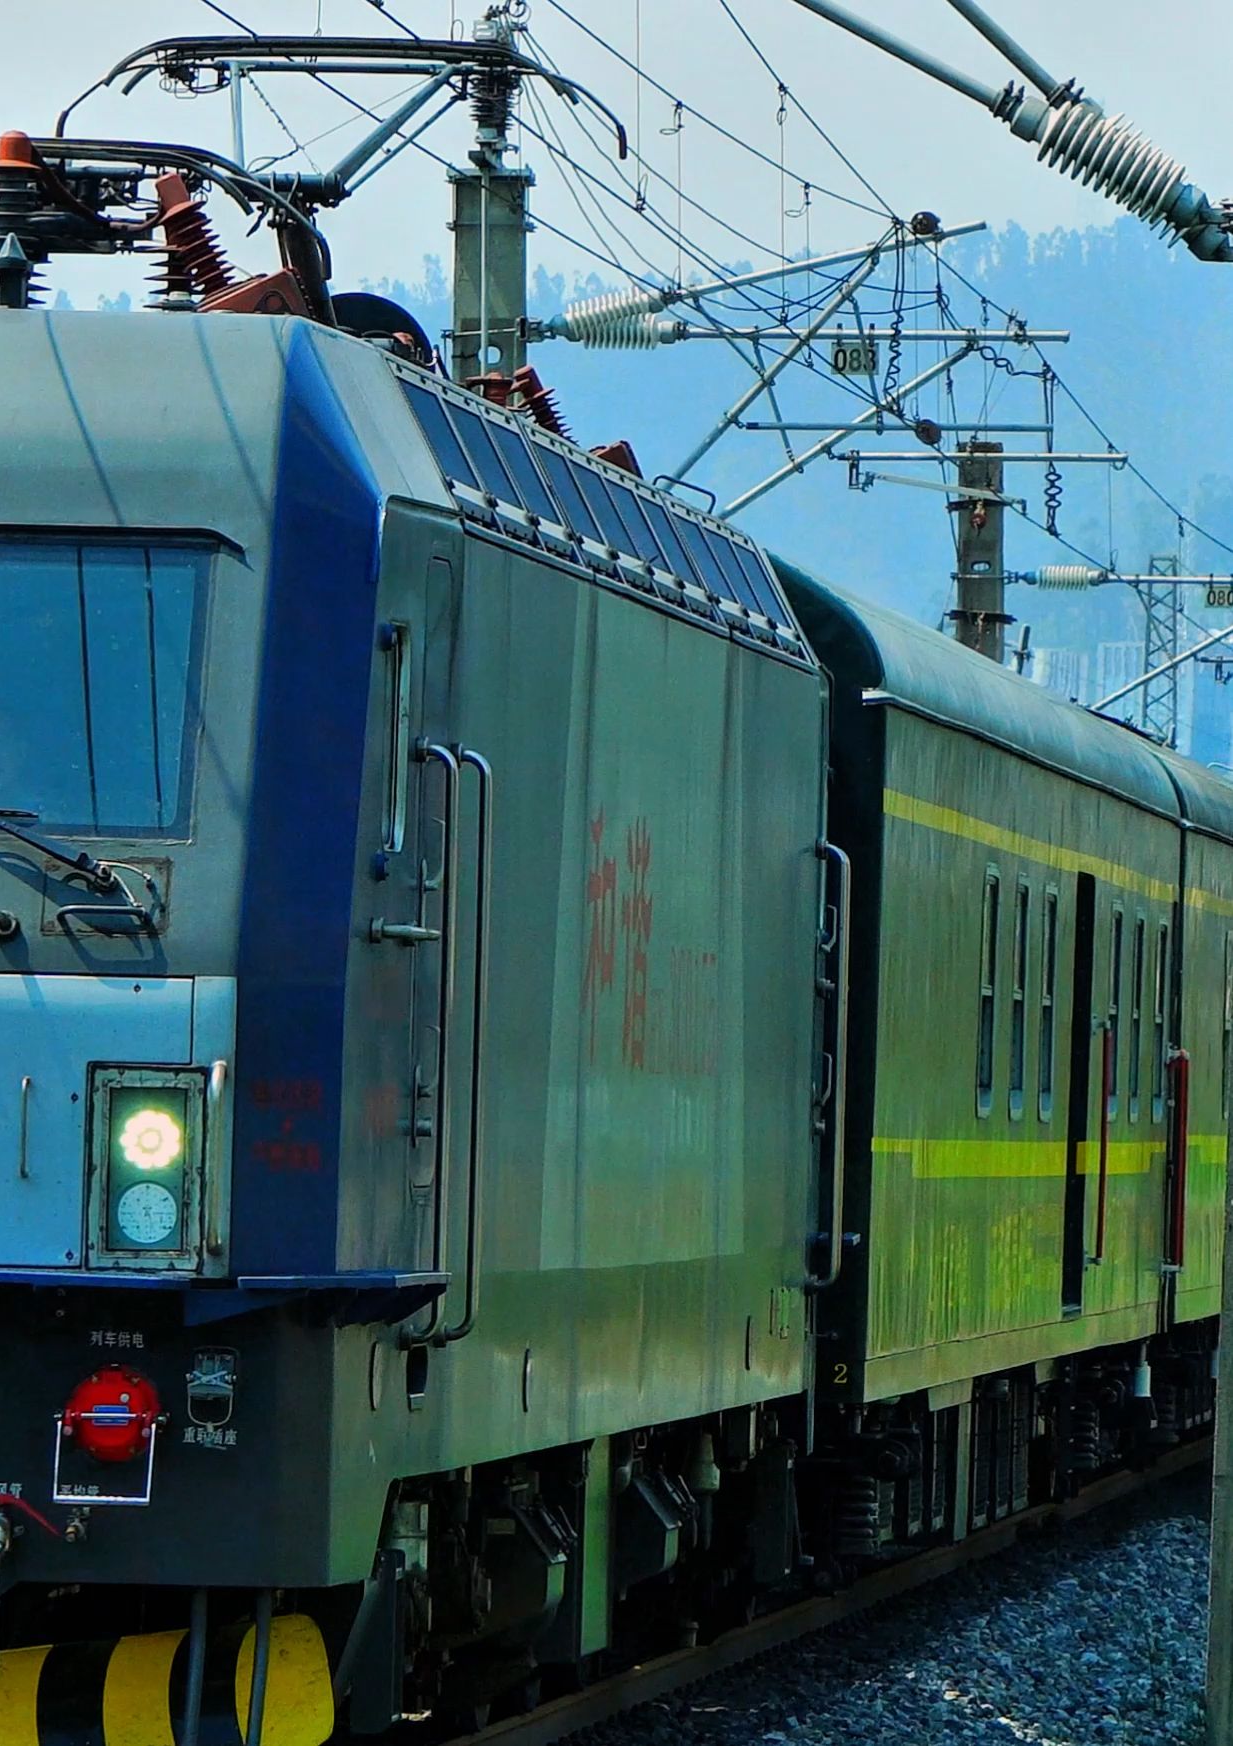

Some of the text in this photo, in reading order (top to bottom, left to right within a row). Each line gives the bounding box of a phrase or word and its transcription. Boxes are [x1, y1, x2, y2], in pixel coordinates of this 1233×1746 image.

[834, 348, 876, 372] 083
[90, 1330, 144, 1348] 列车供电
[834, 1363, 848, 1384] 2
